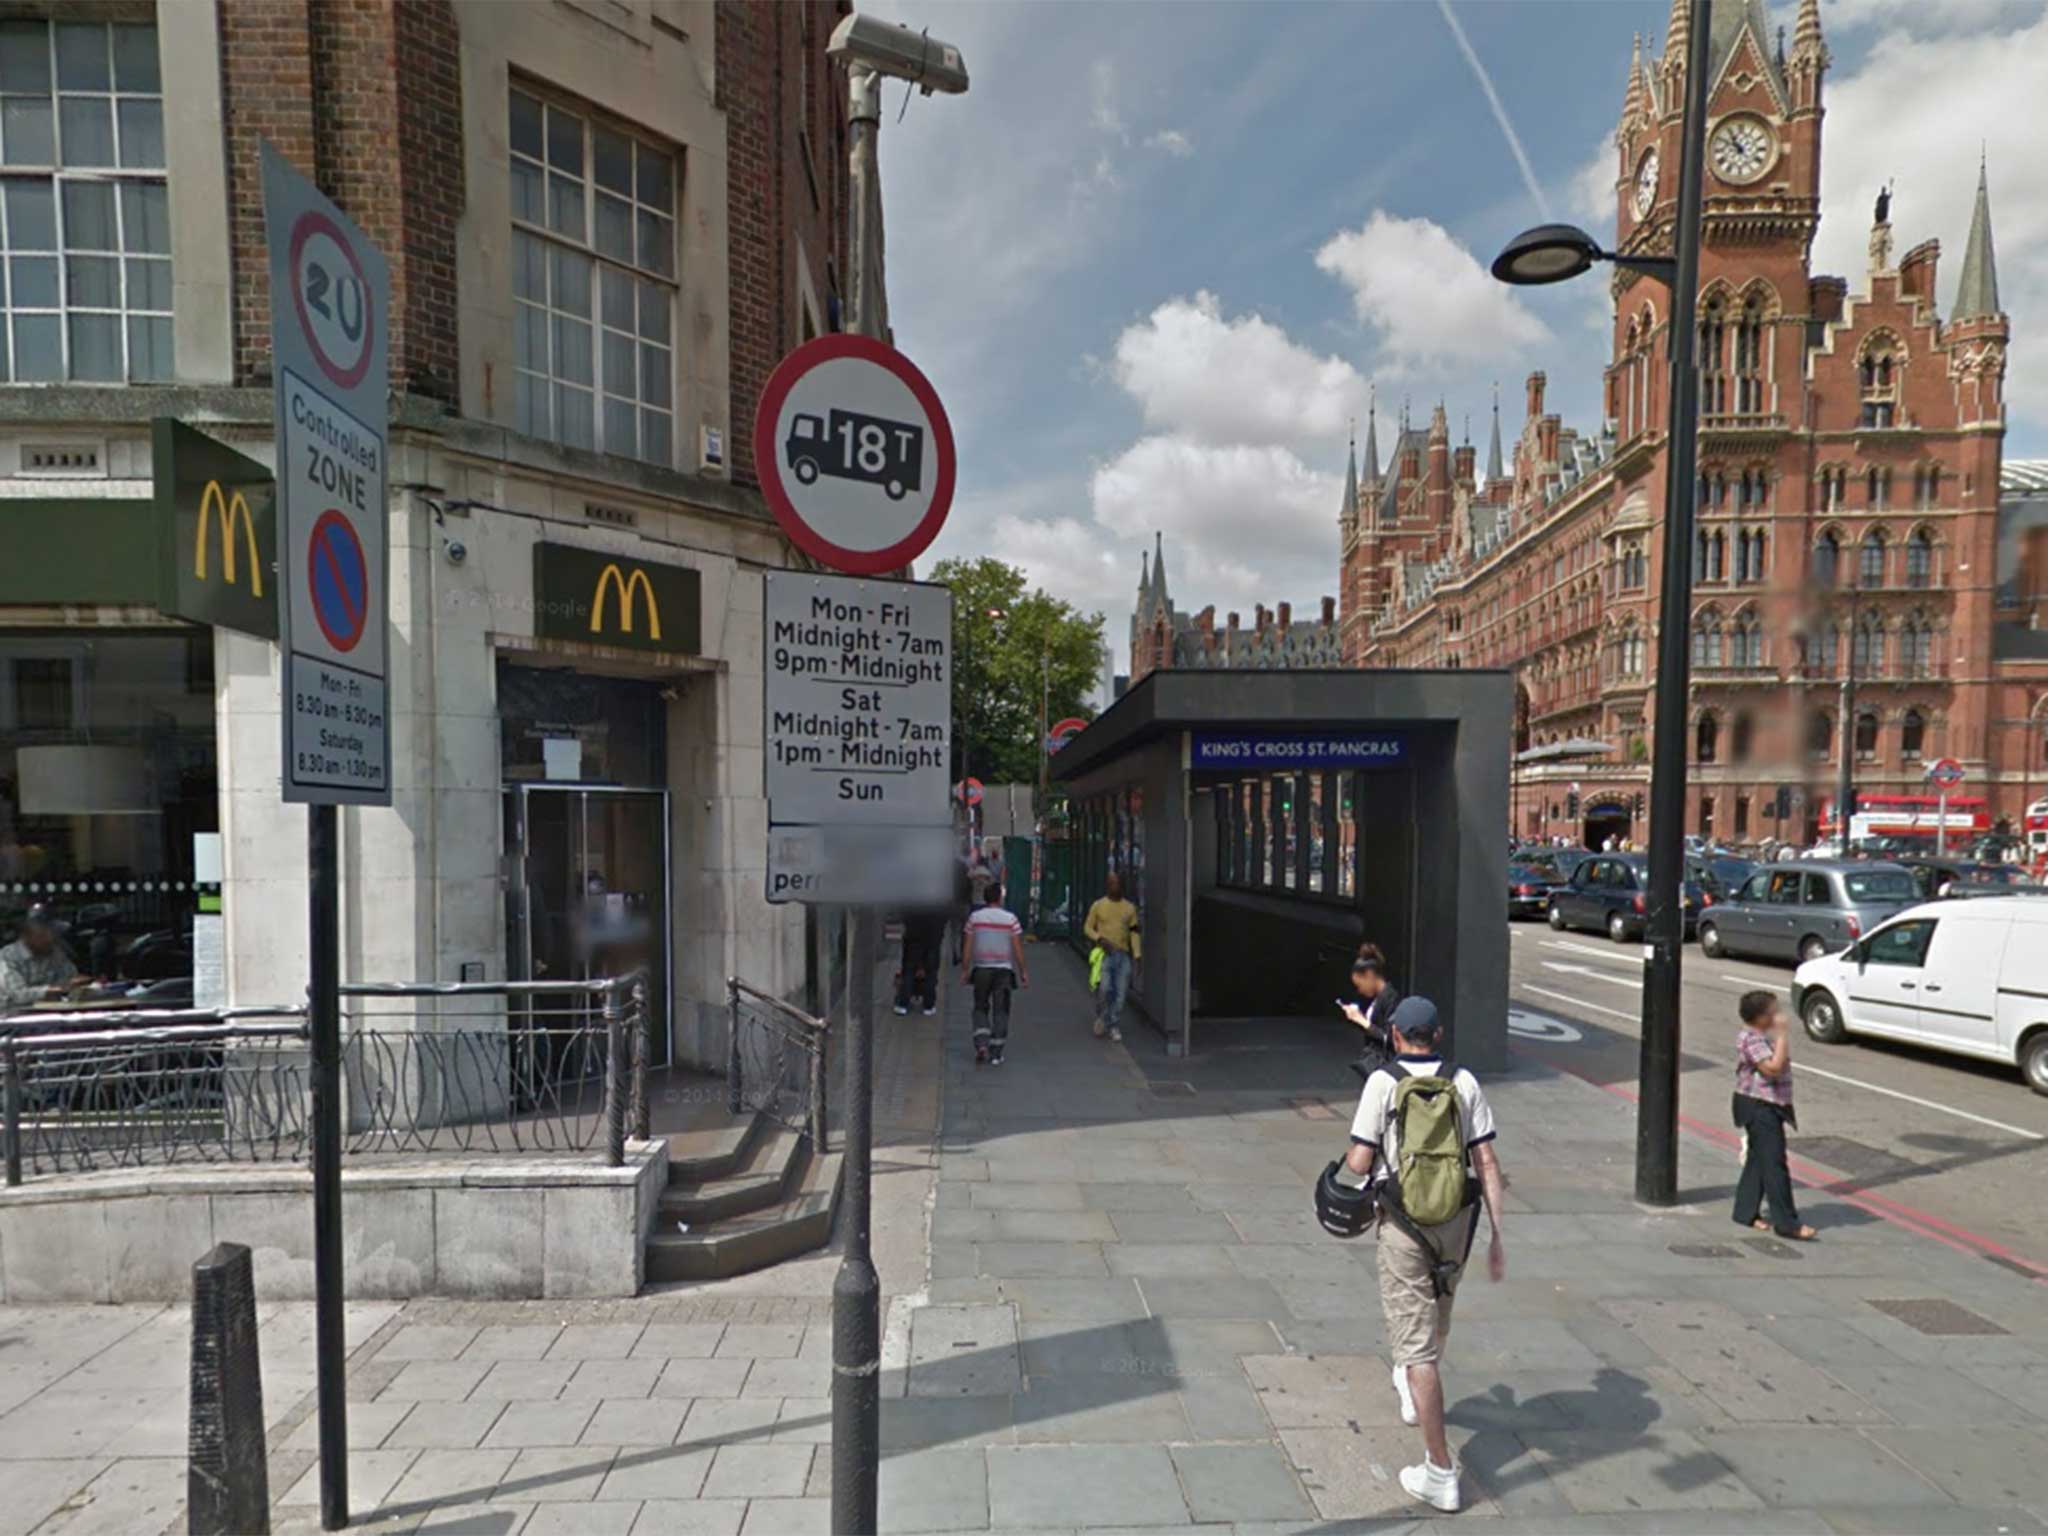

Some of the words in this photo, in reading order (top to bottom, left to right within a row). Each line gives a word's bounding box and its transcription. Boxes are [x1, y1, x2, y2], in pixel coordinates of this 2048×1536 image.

[307, 261, 363, 342] 20
[292, 392, 377, 473] Controlled
[307, 444, 366, 512] ZONE
[841, 688, 882, 712] Sat
[320, 728, 363, 755] Saturday
[1201, 741, 1251, 758] KING'S
[1255, 743, 1304, 758] CROSS
[838, 778, 883, 801] Sun
